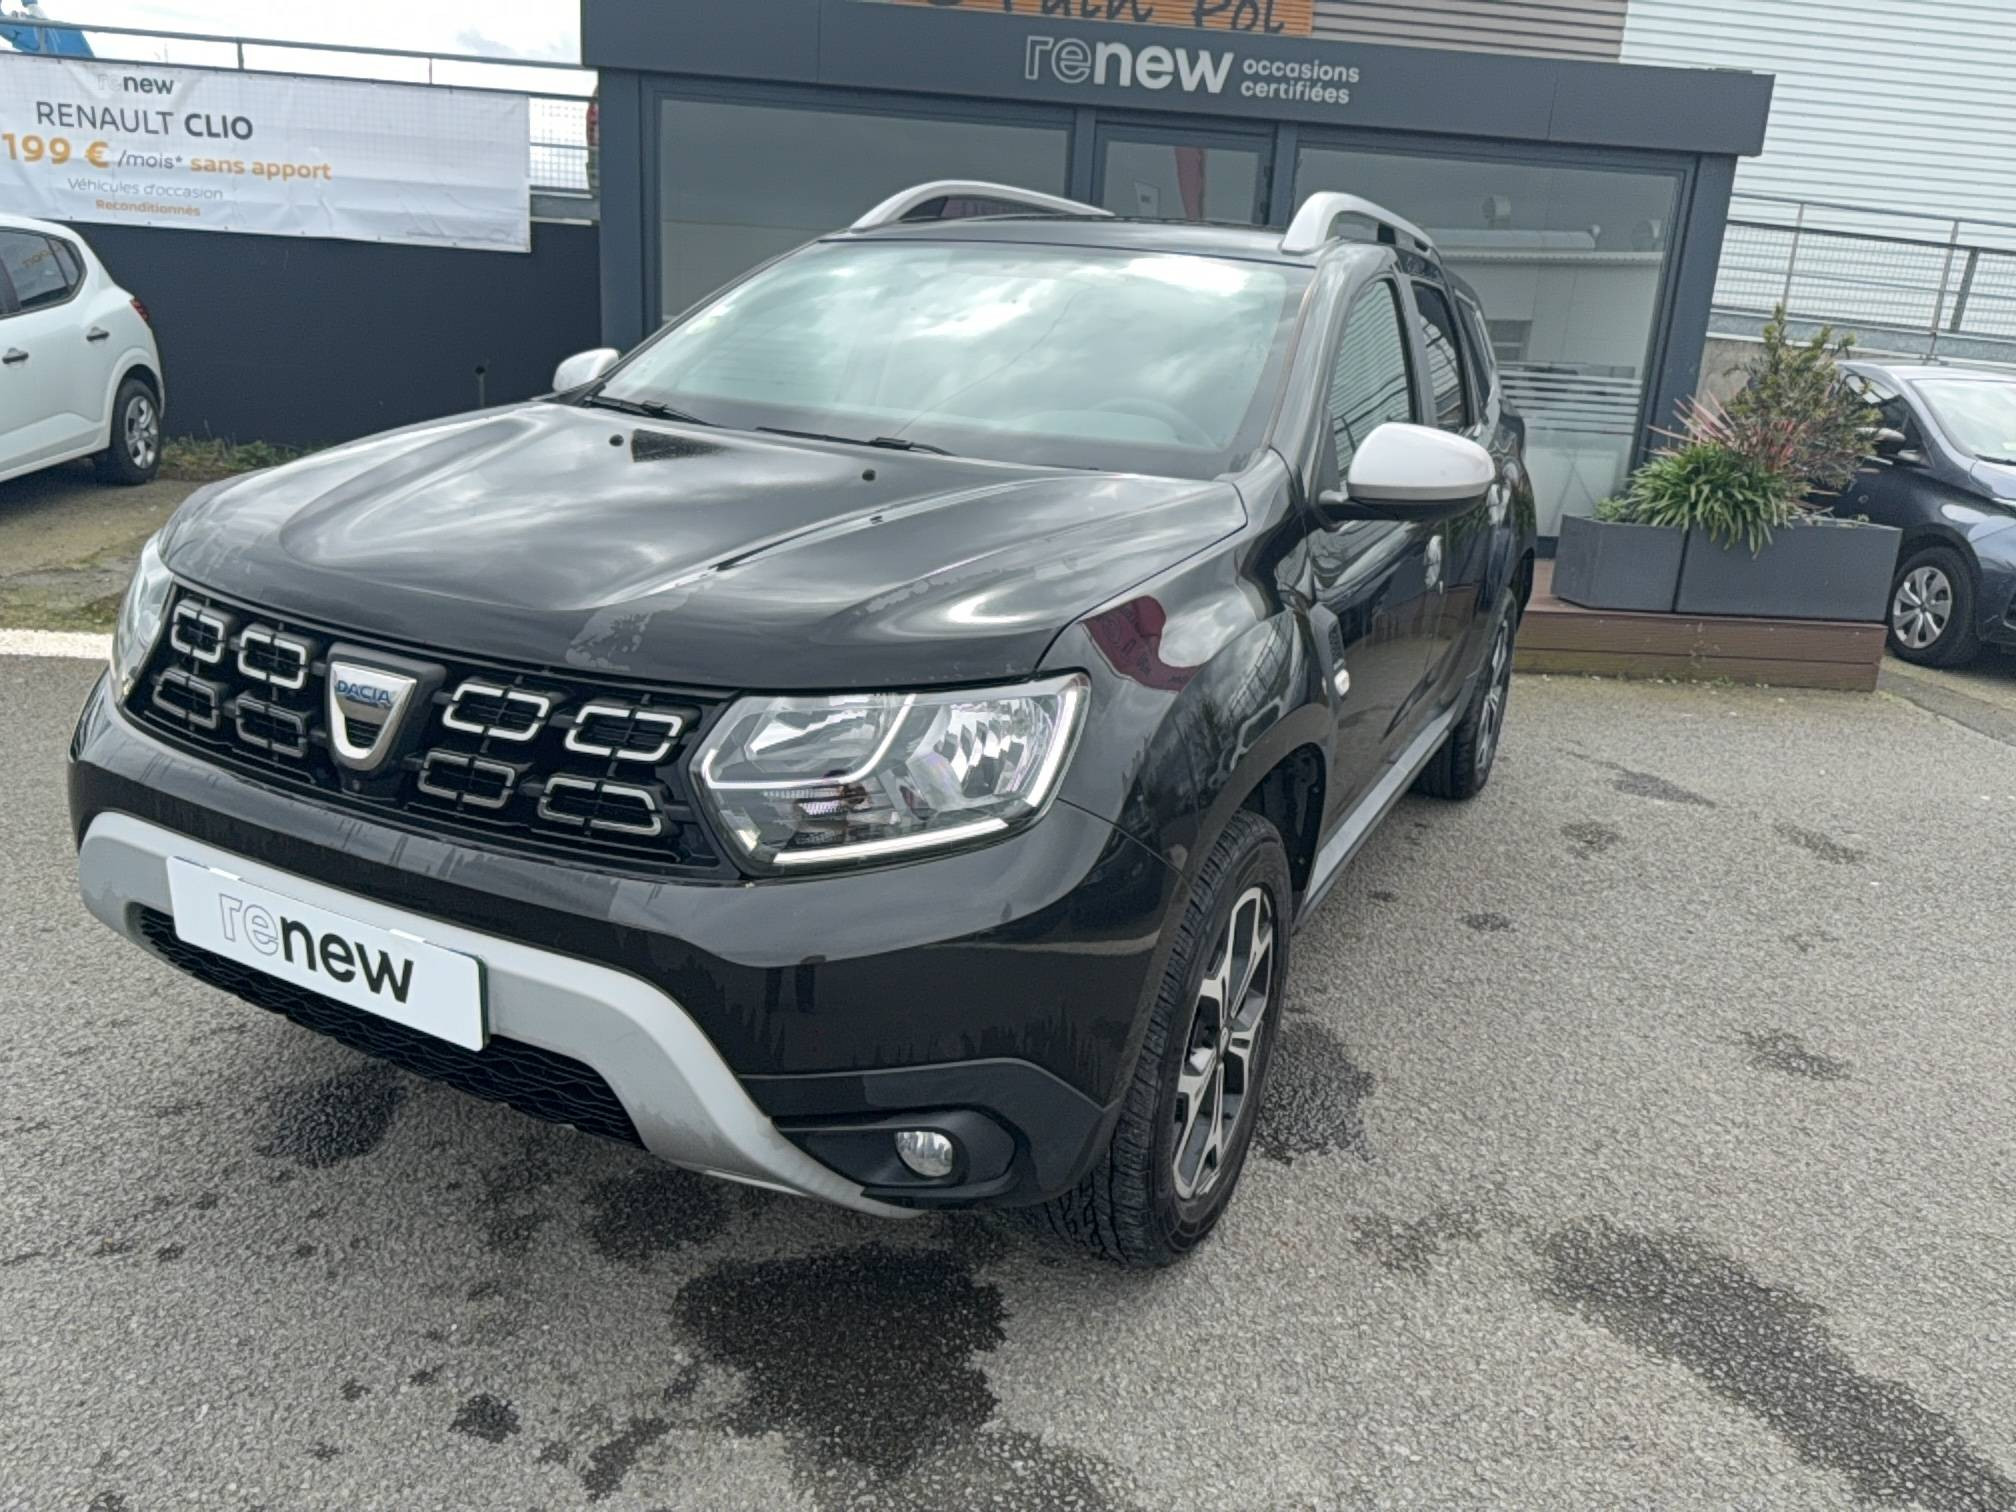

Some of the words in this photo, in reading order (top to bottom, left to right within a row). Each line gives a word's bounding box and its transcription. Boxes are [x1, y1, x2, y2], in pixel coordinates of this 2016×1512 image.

[1025, 35, 1234, 93] renew
[1243, 58, 1360, 83] occasions
[1240, 78, 1350, 104] certifiées
[36, 101, 174, 136] RENAULT
[184, 113, 254, 140] CLIO
[2, 132, 72, 166] 199
[85, 140, 109, 169] €
[190, 157, 246, 175] sans
[251, 160, 333, 181] apport
[67, 177, 140, 194] Véhicules
[95, 199, 201, 217] Reconditionnés
[336, 679, 391, 705] DACIA
[218, 893, 415, 1004] renew
